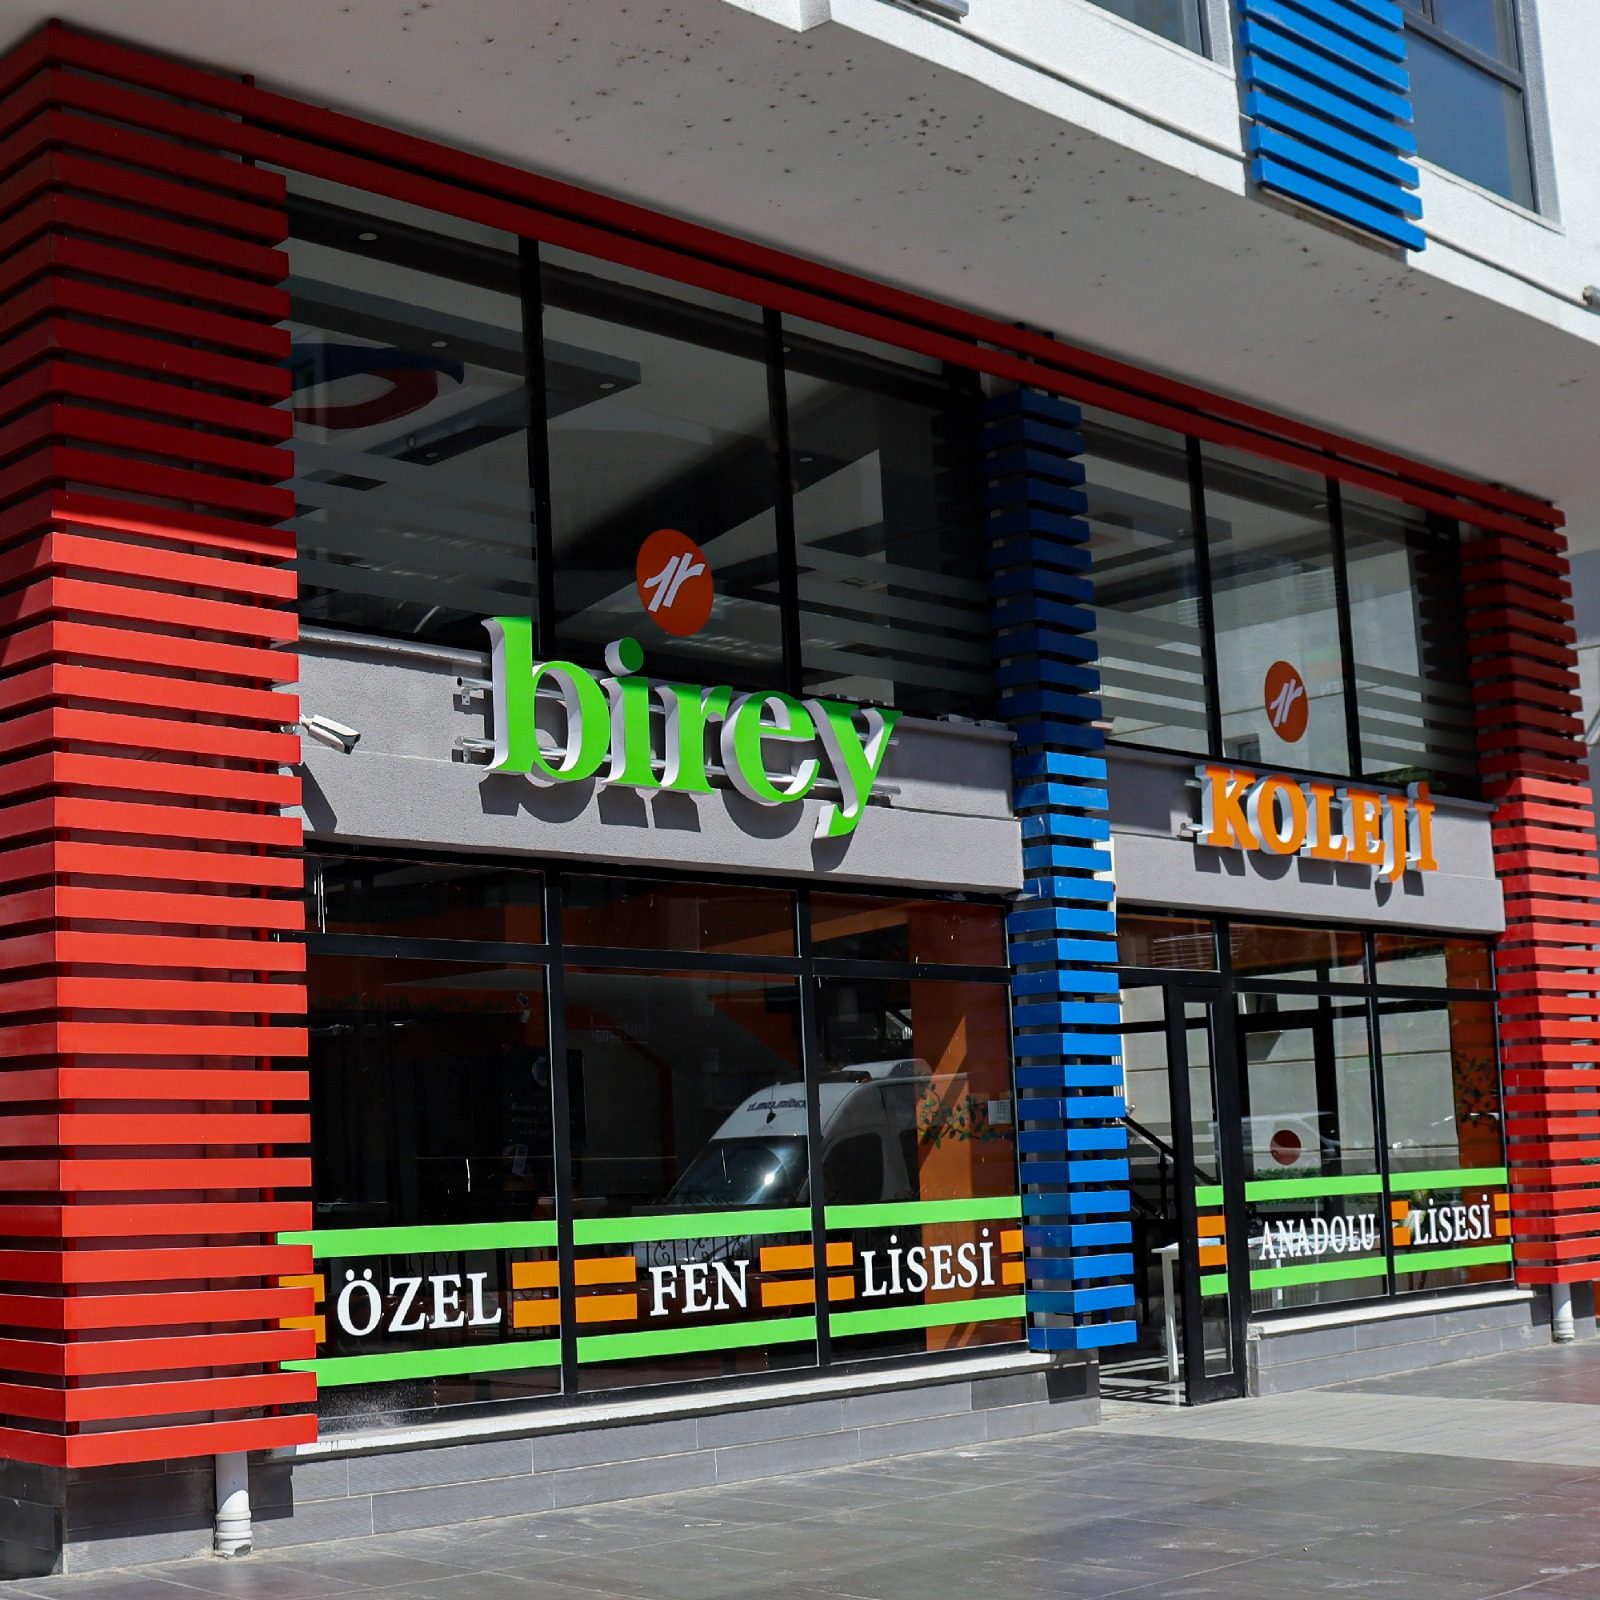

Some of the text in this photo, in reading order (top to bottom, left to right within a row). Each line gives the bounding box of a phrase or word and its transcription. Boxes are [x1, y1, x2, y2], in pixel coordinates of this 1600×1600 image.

[481, 616, 903, 839] birey
[1195, 764, 1440, 884] KOLEJİ
[337, 1227, 996, 1337] ÖZEL FEN LİSESİ
[1258, 1194, 1493, 1260] ANADOLU LİSESİ
